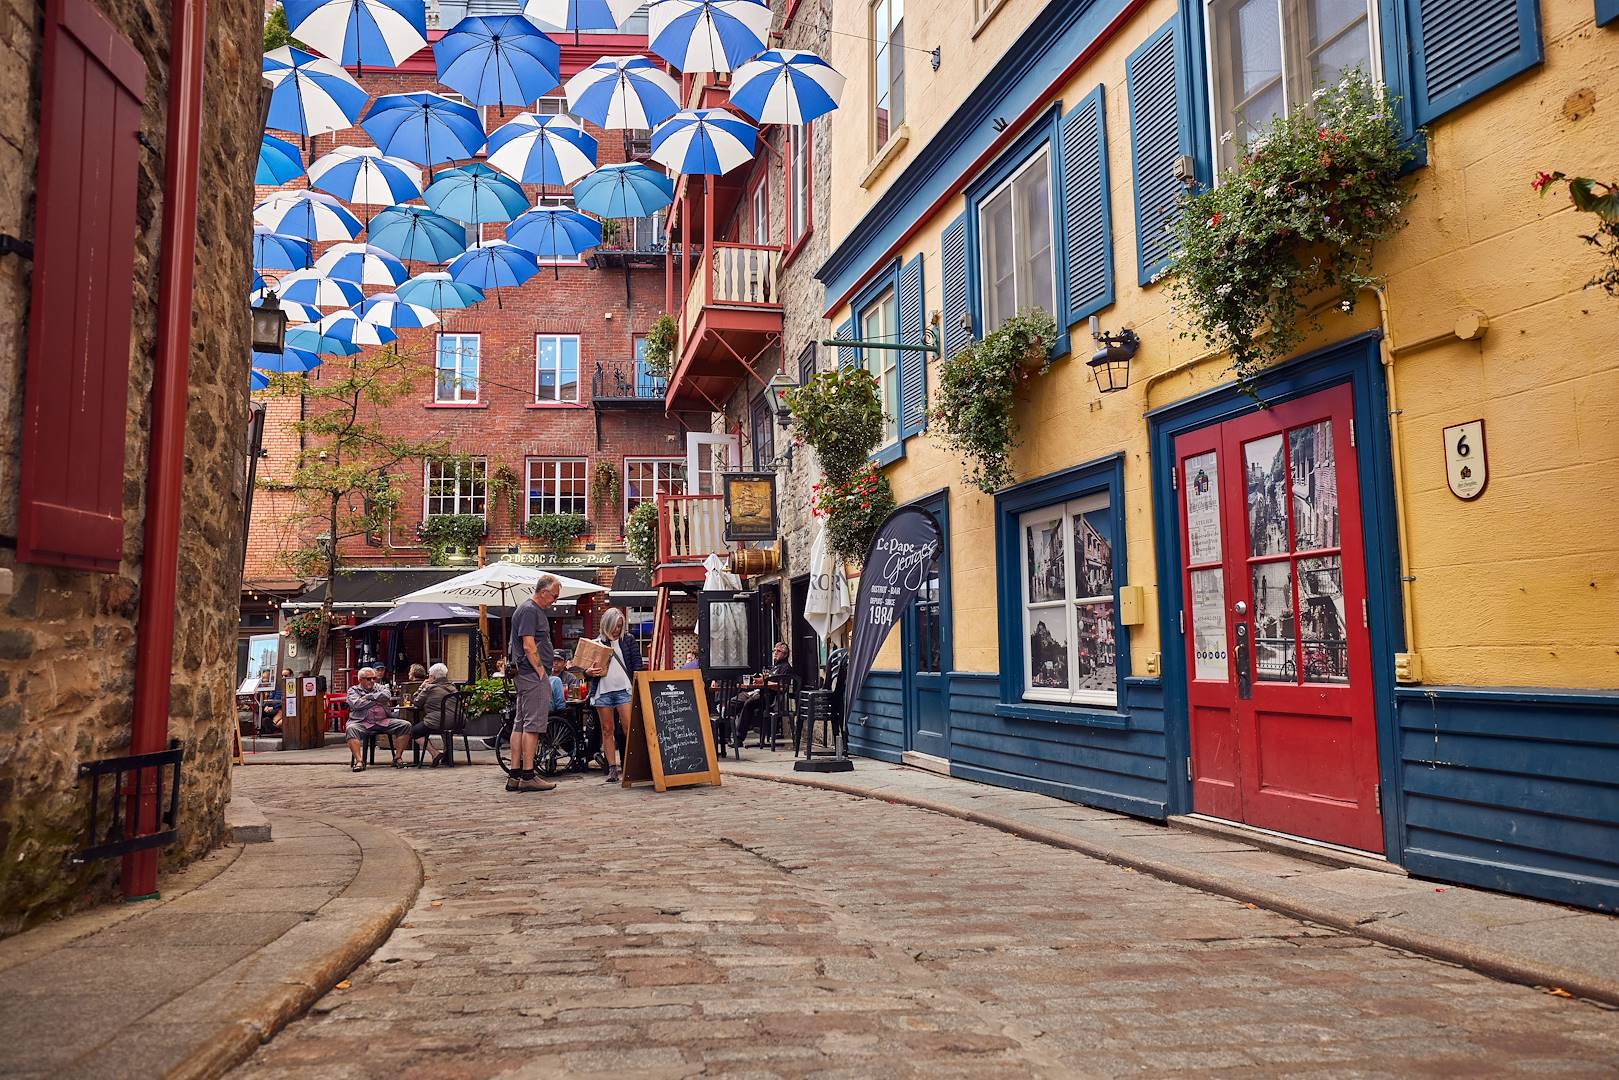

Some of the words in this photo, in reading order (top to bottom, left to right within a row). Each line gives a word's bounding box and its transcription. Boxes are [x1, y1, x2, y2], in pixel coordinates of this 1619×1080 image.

[1457, 434, 1470, 457] 6
[876, 538, 889, 550] Le
[889, 538, 915, 555] Pape
[883, 539, 938, 591] Georges
[870, 605, 894, 627] 1984
